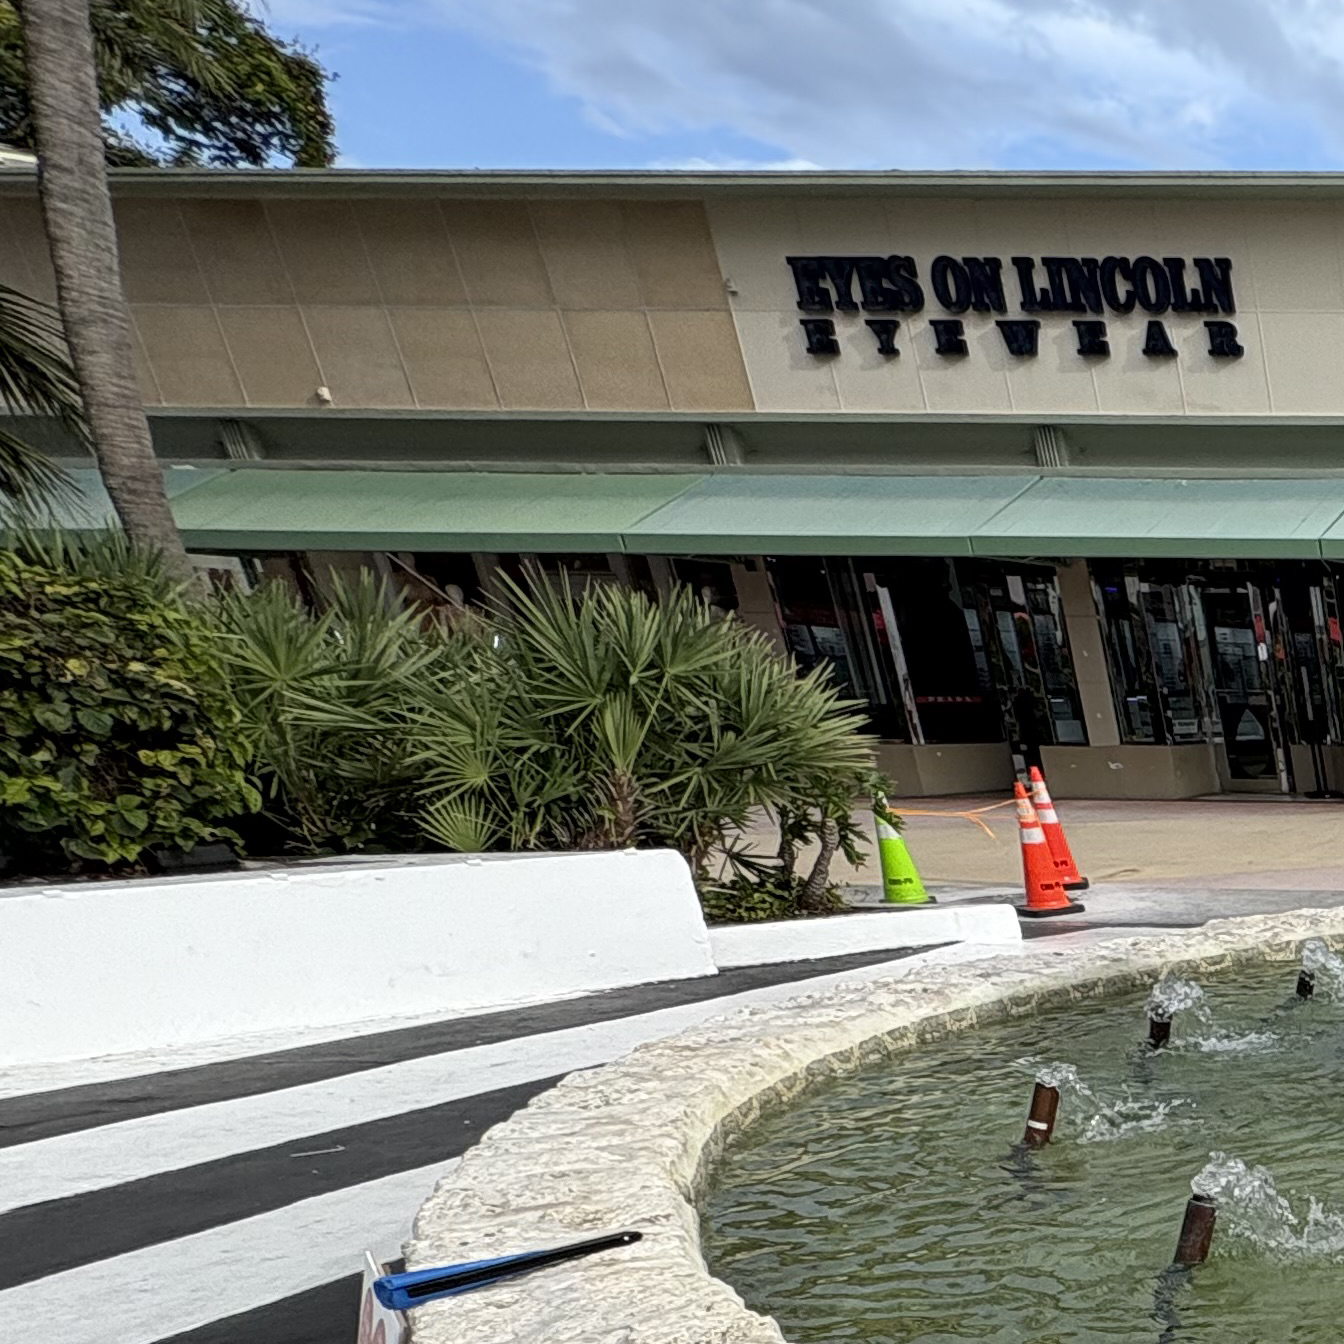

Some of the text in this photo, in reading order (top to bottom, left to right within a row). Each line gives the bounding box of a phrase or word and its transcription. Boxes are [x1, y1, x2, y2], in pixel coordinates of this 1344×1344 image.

[785, 255, 1236, 313] EYES ON LINCOLN
[799, 318, 1244, 357] EYEWEAR
